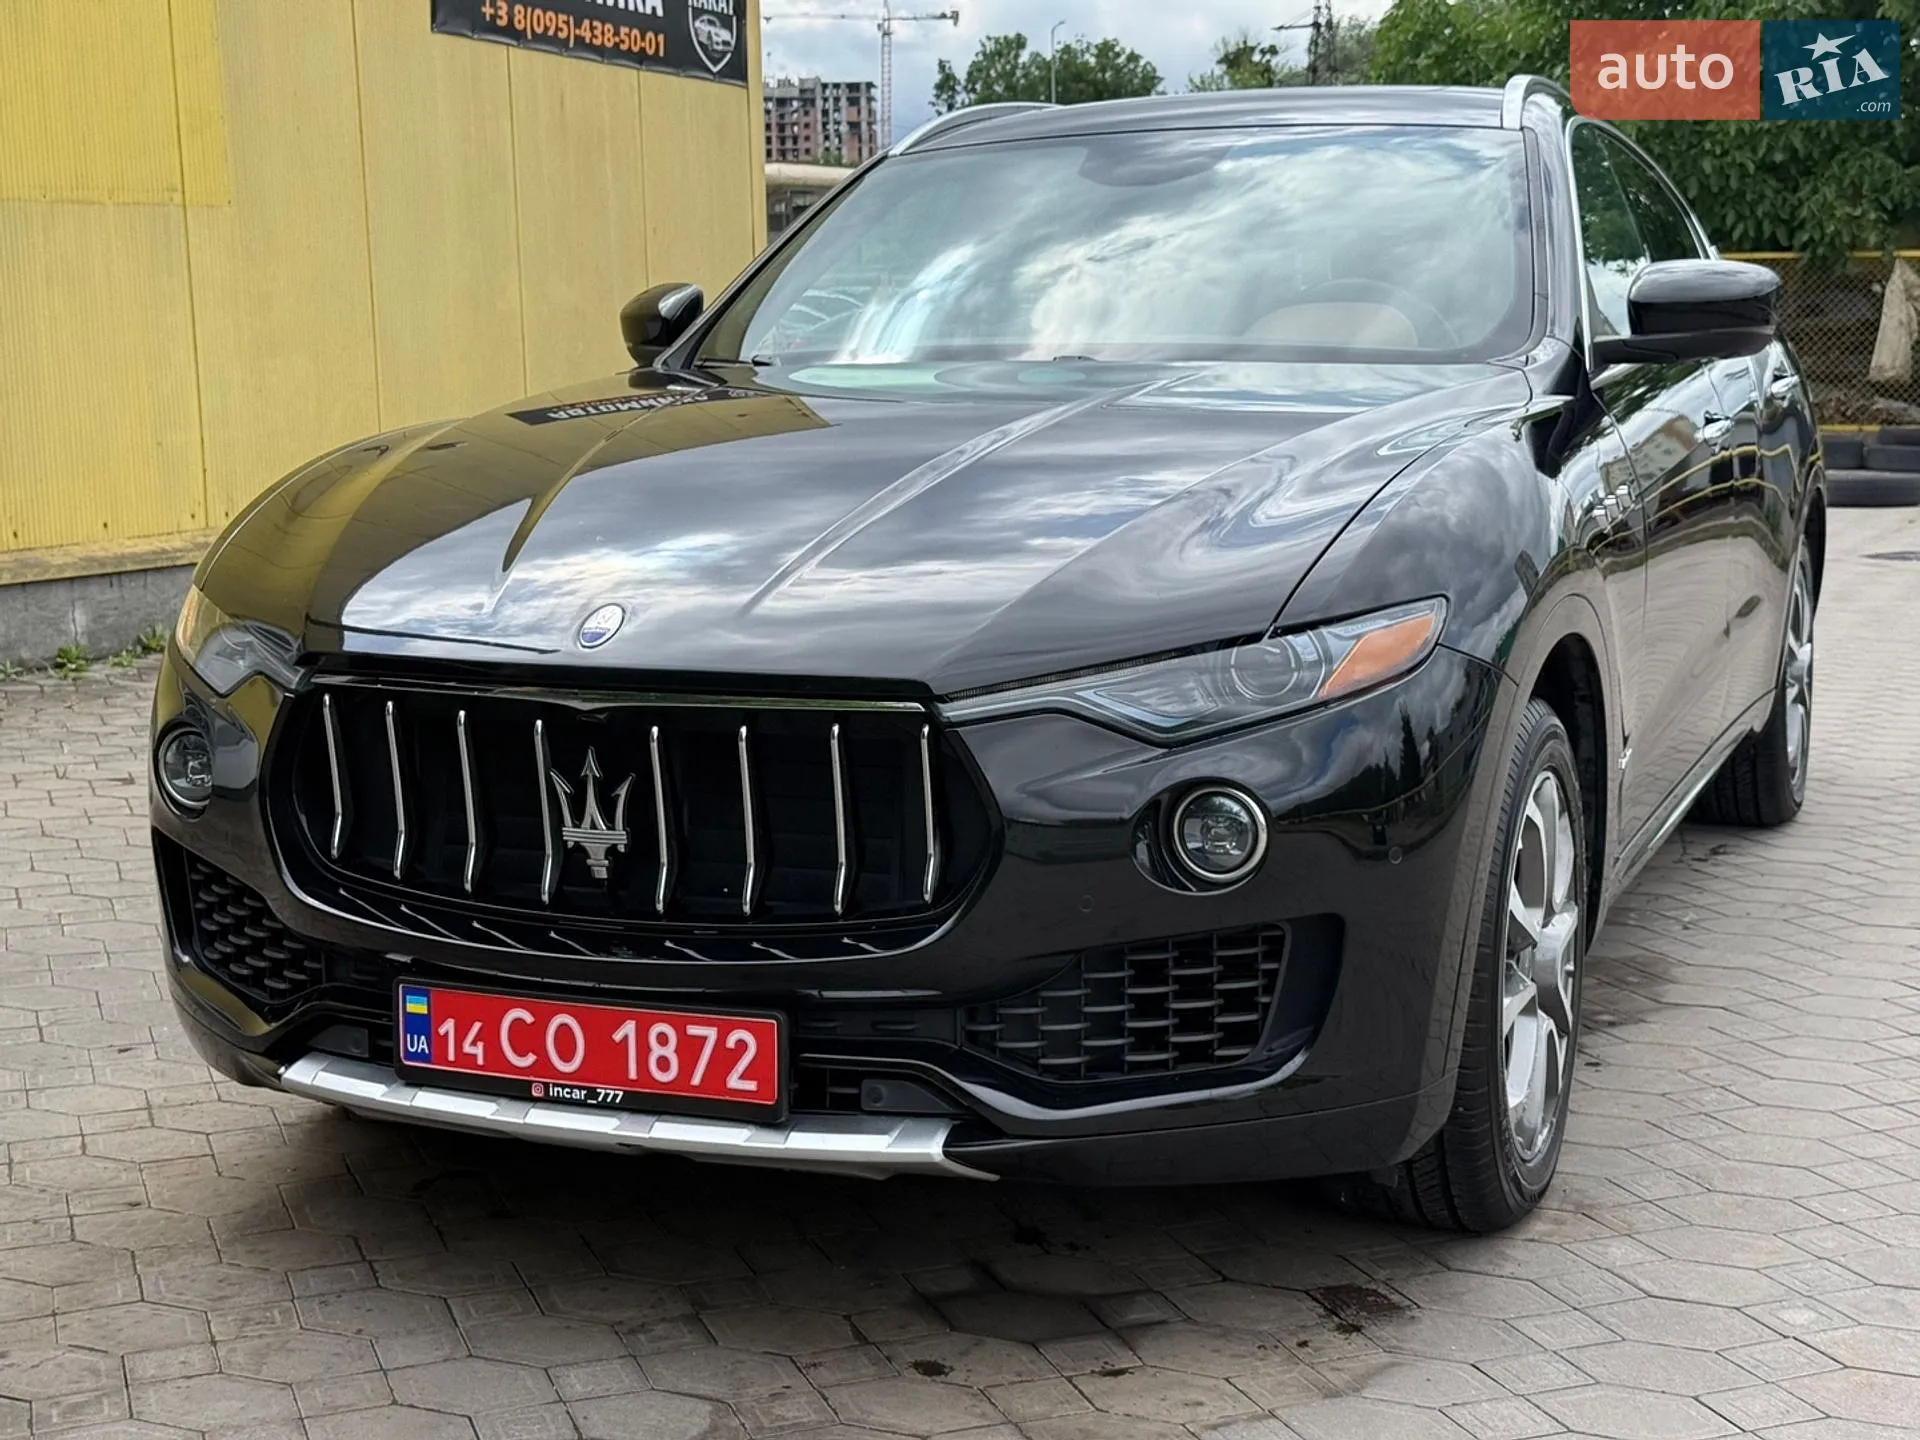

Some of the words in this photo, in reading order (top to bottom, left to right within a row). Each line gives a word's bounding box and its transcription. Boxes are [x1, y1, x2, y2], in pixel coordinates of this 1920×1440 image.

[481, 0, 508, 27] +3
[513, 4, 665, 57] 8(095)-438-50-01
[407, 1034, 429, 1054] UA
[437, 1018, 484, 1066] 14
[500, 1008, 585, 1073] CO
[611, 1019, 758, 1091] 1872
[549, 1083, 624, 1104] incar_777
